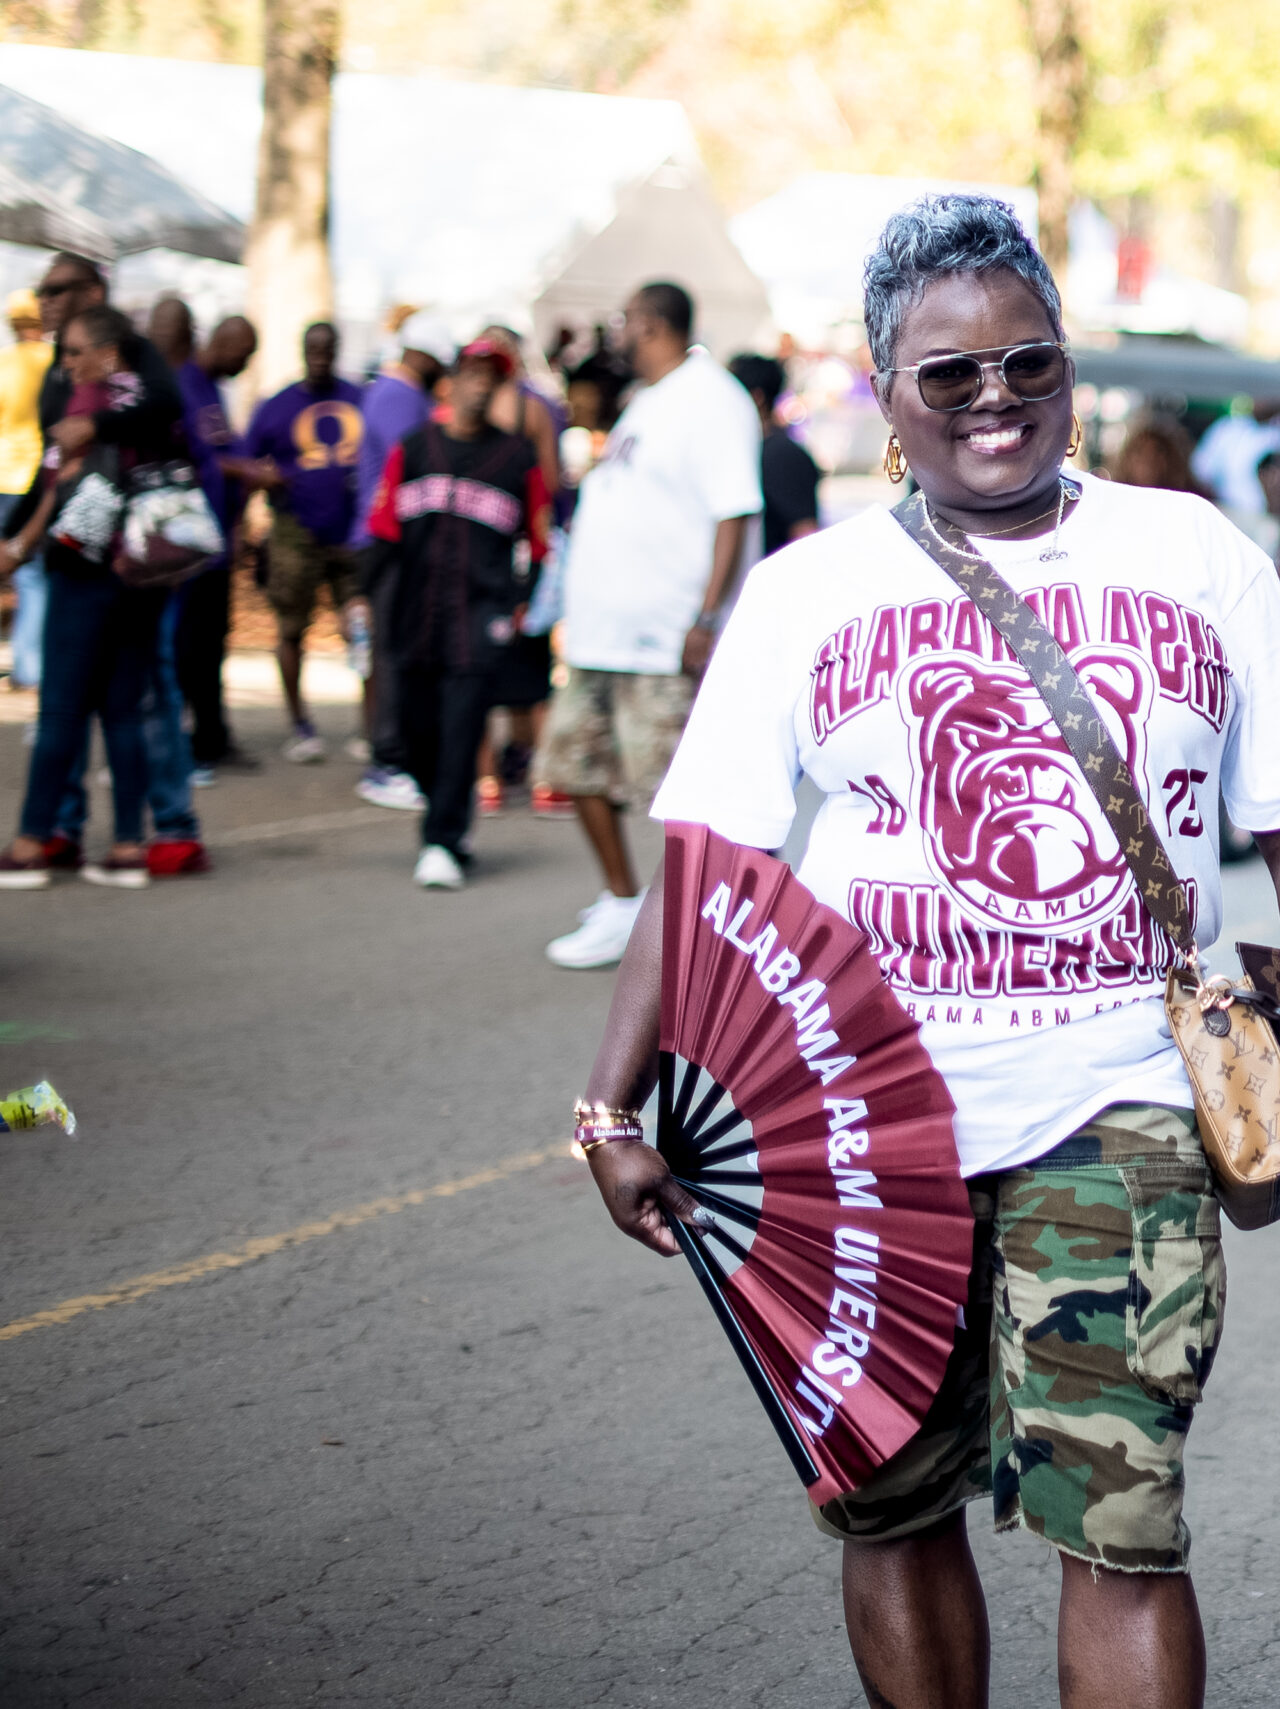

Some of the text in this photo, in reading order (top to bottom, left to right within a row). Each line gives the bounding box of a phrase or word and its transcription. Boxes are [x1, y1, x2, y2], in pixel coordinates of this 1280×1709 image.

[1162, 768, 1208, 838] 75
[984, 886, 1095, 921] AAMU
[1010, 1006, 1071, 1027] A&M
[701, 879, 857, 1087] ALABAMA
[825, 1097, 884, 1208] A&M
